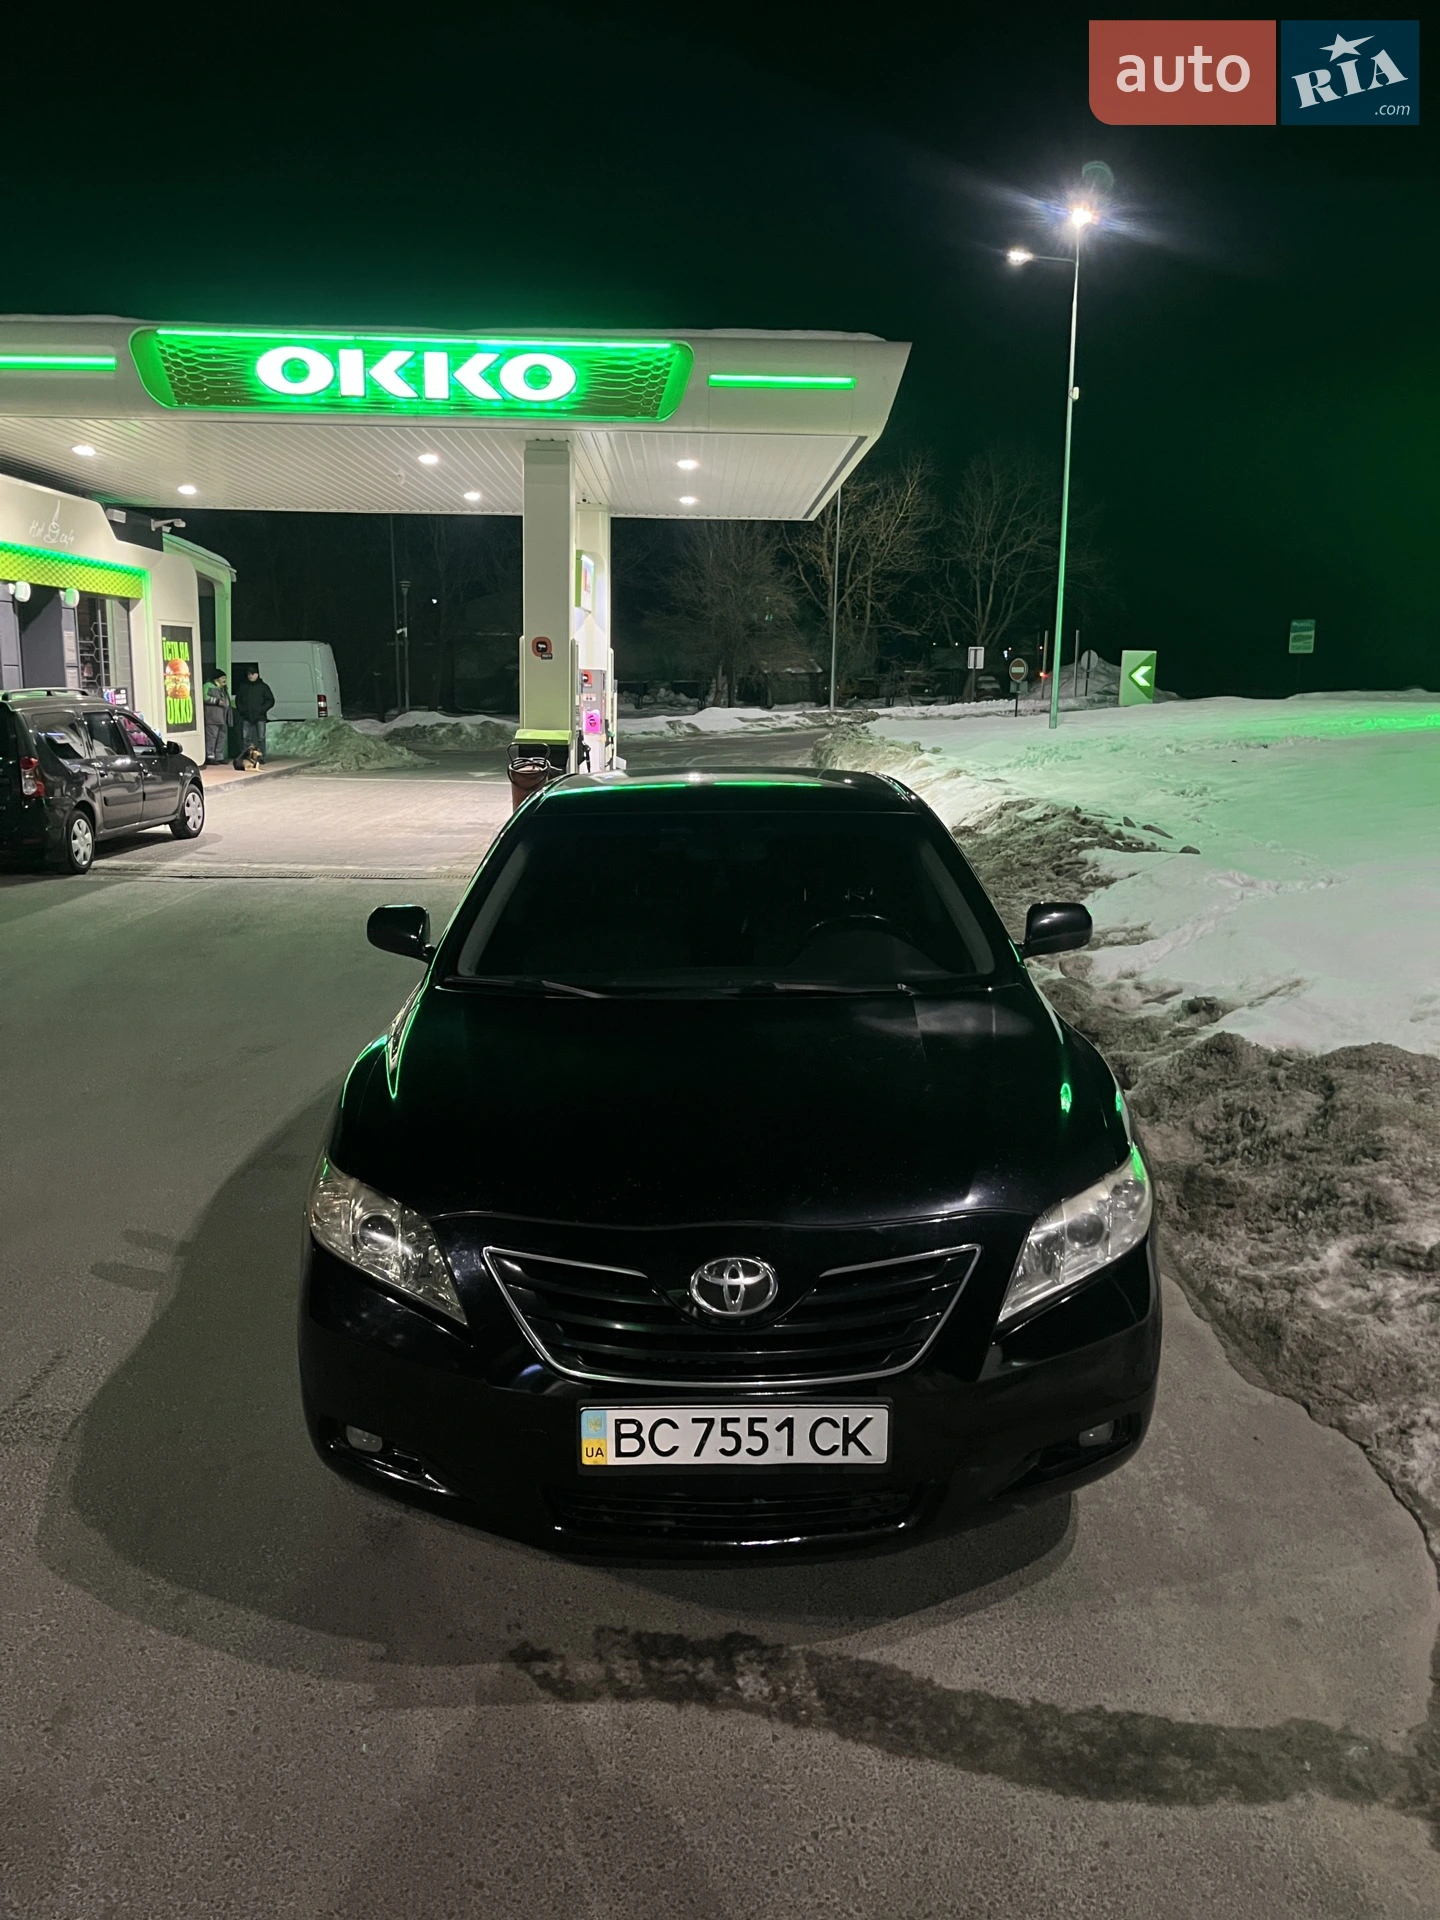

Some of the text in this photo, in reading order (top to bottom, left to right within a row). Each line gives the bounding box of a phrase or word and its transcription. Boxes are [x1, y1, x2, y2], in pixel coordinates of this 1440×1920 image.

[256, 346, 577, 402] OKKO
[585, 1447, 604, 1458] UA
[614, 1415, 874, 1458] BC 7551 CK
